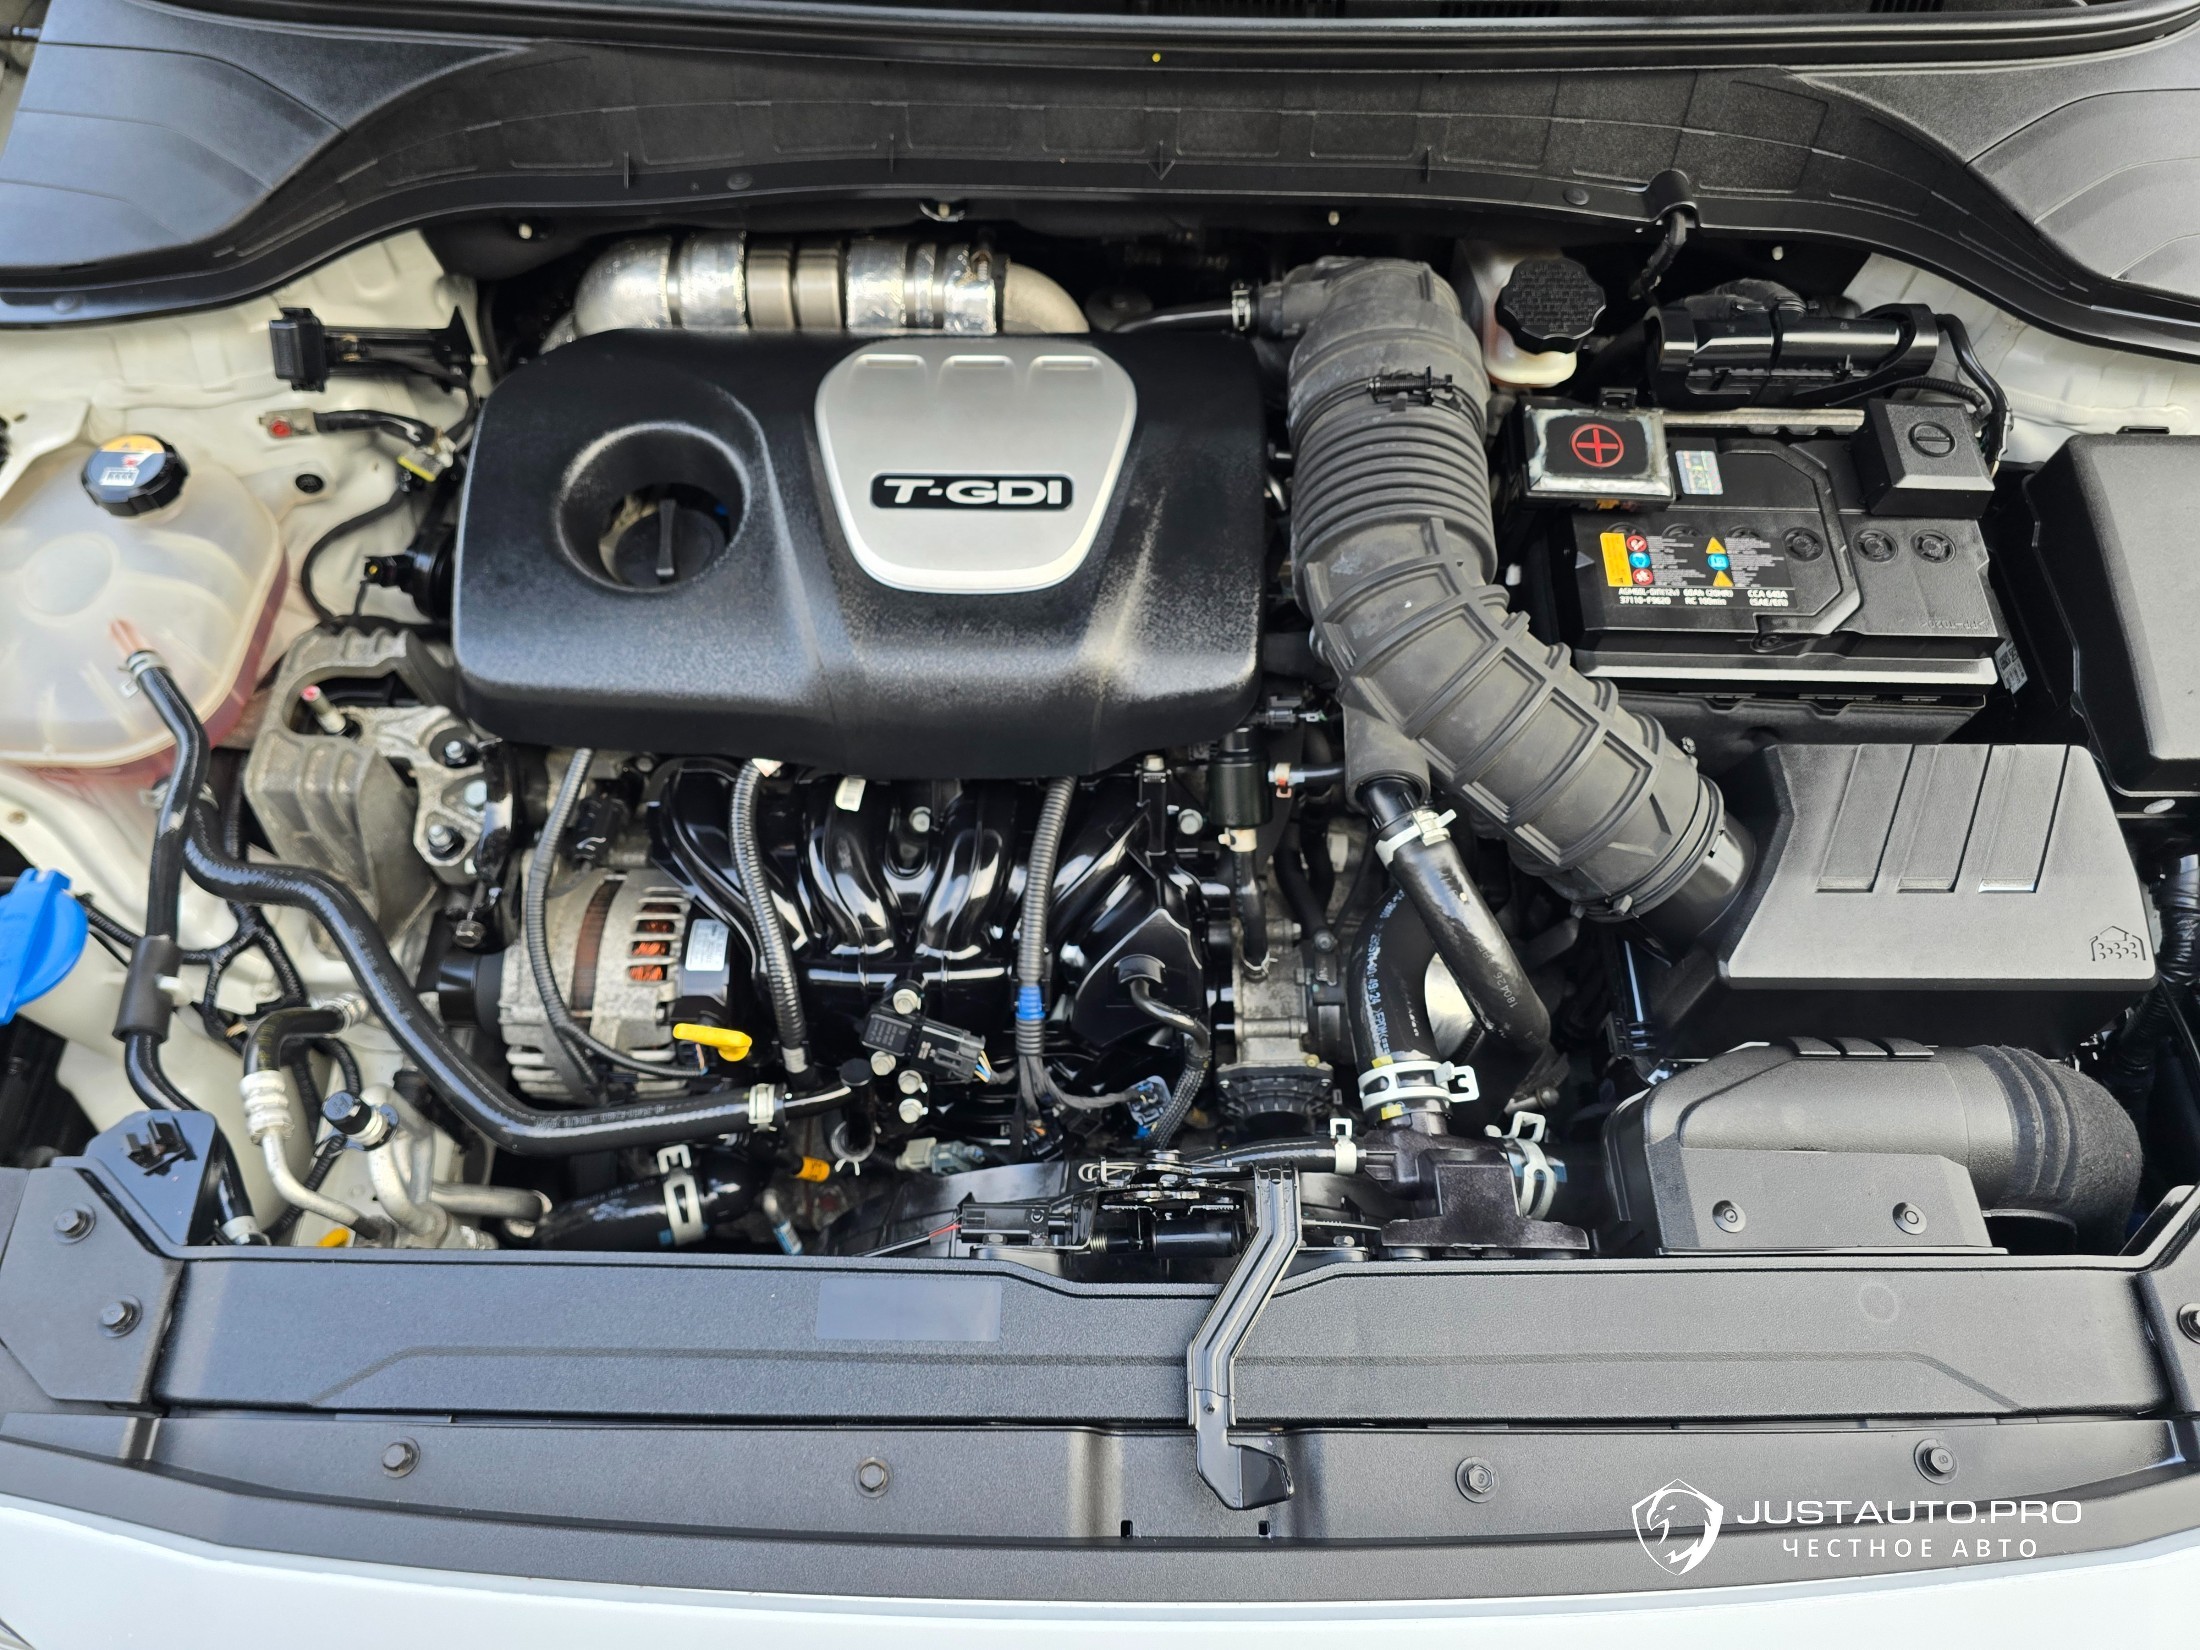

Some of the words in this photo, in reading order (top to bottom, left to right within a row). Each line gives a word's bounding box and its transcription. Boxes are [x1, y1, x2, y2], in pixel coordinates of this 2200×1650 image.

[884, 478, 1062, 505] T-GDI
[1684, 597, 1697, 605] RC
[1747, 590, 1765, 598] CCA
[1493, 972, 1518, 1008] 180426
